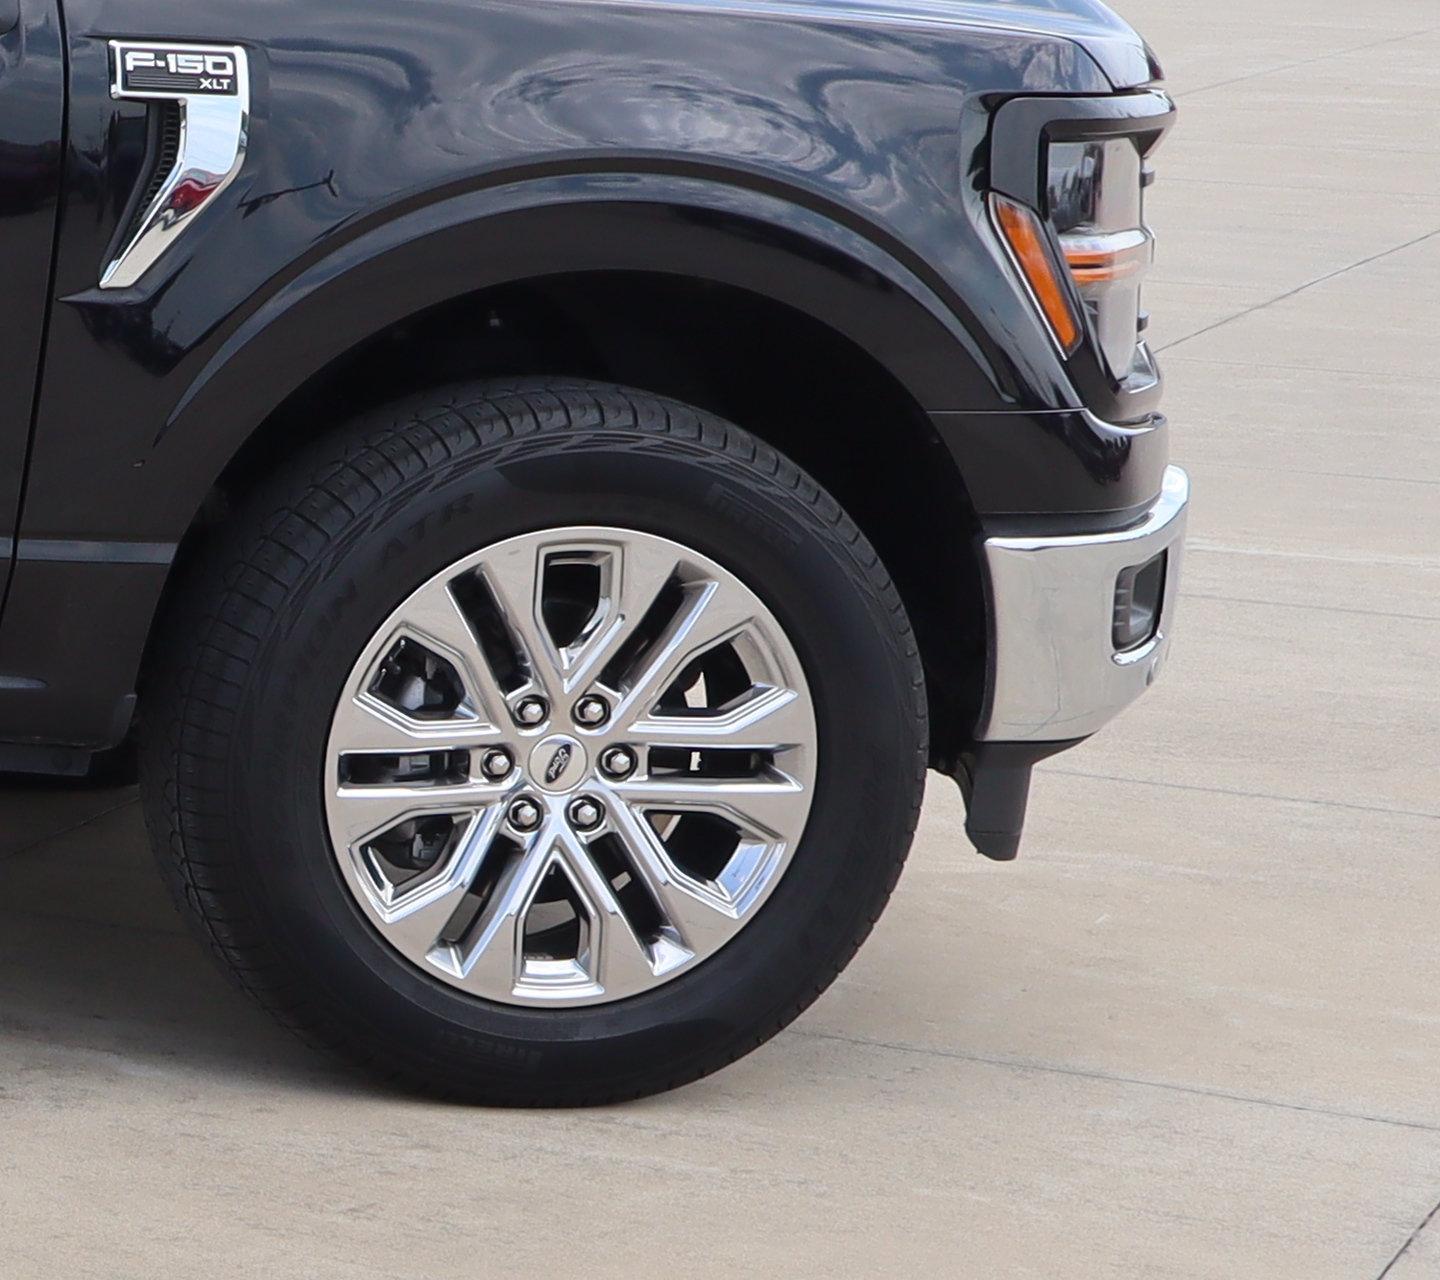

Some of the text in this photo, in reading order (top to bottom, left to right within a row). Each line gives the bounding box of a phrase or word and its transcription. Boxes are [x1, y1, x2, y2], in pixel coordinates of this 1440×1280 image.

[125, 51, 234, 76] F-150
[198, 77, 232, 91] XLT
[548, 747, 570, 780] Ford
